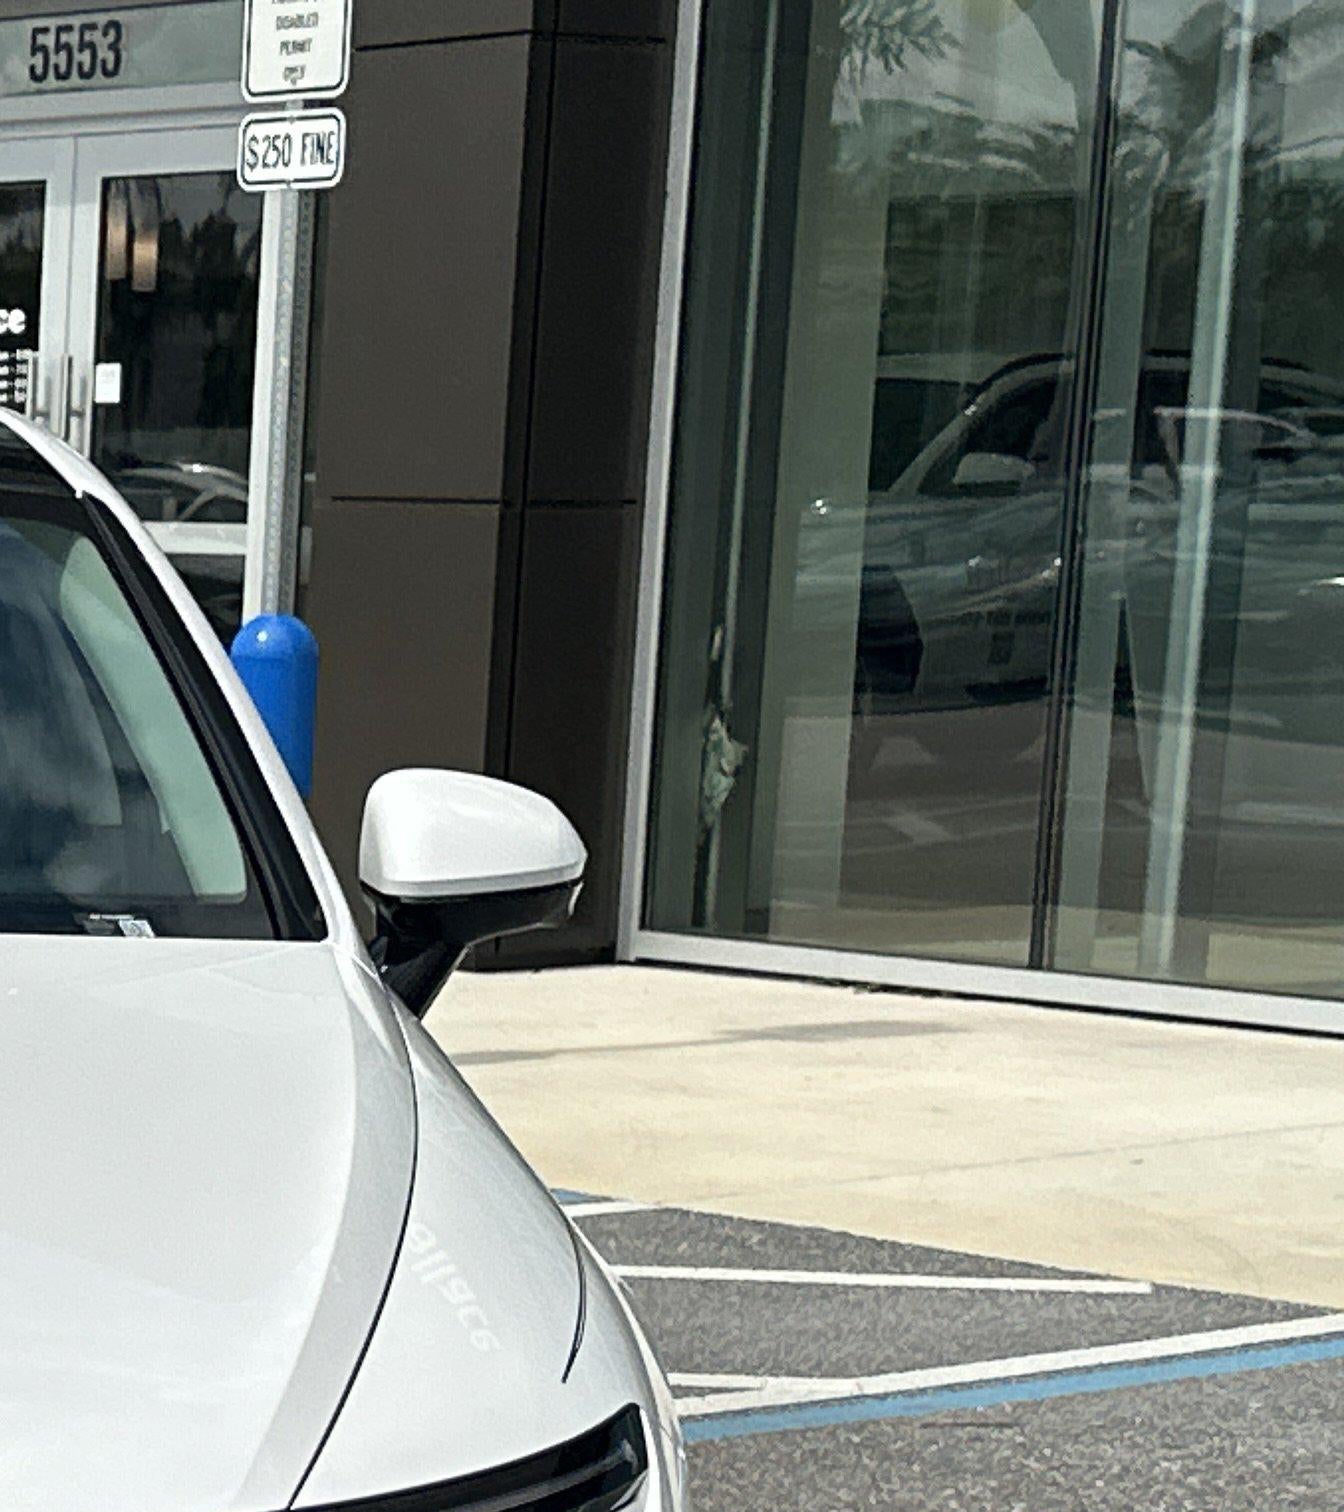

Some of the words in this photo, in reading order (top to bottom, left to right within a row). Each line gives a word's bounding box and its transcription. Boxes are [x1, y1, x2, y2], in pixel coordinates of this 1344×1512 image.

[29, 20, 123, 83] 5553
[246, 133, 292, 172] $250
[300, 131, 335, 166] FINE
